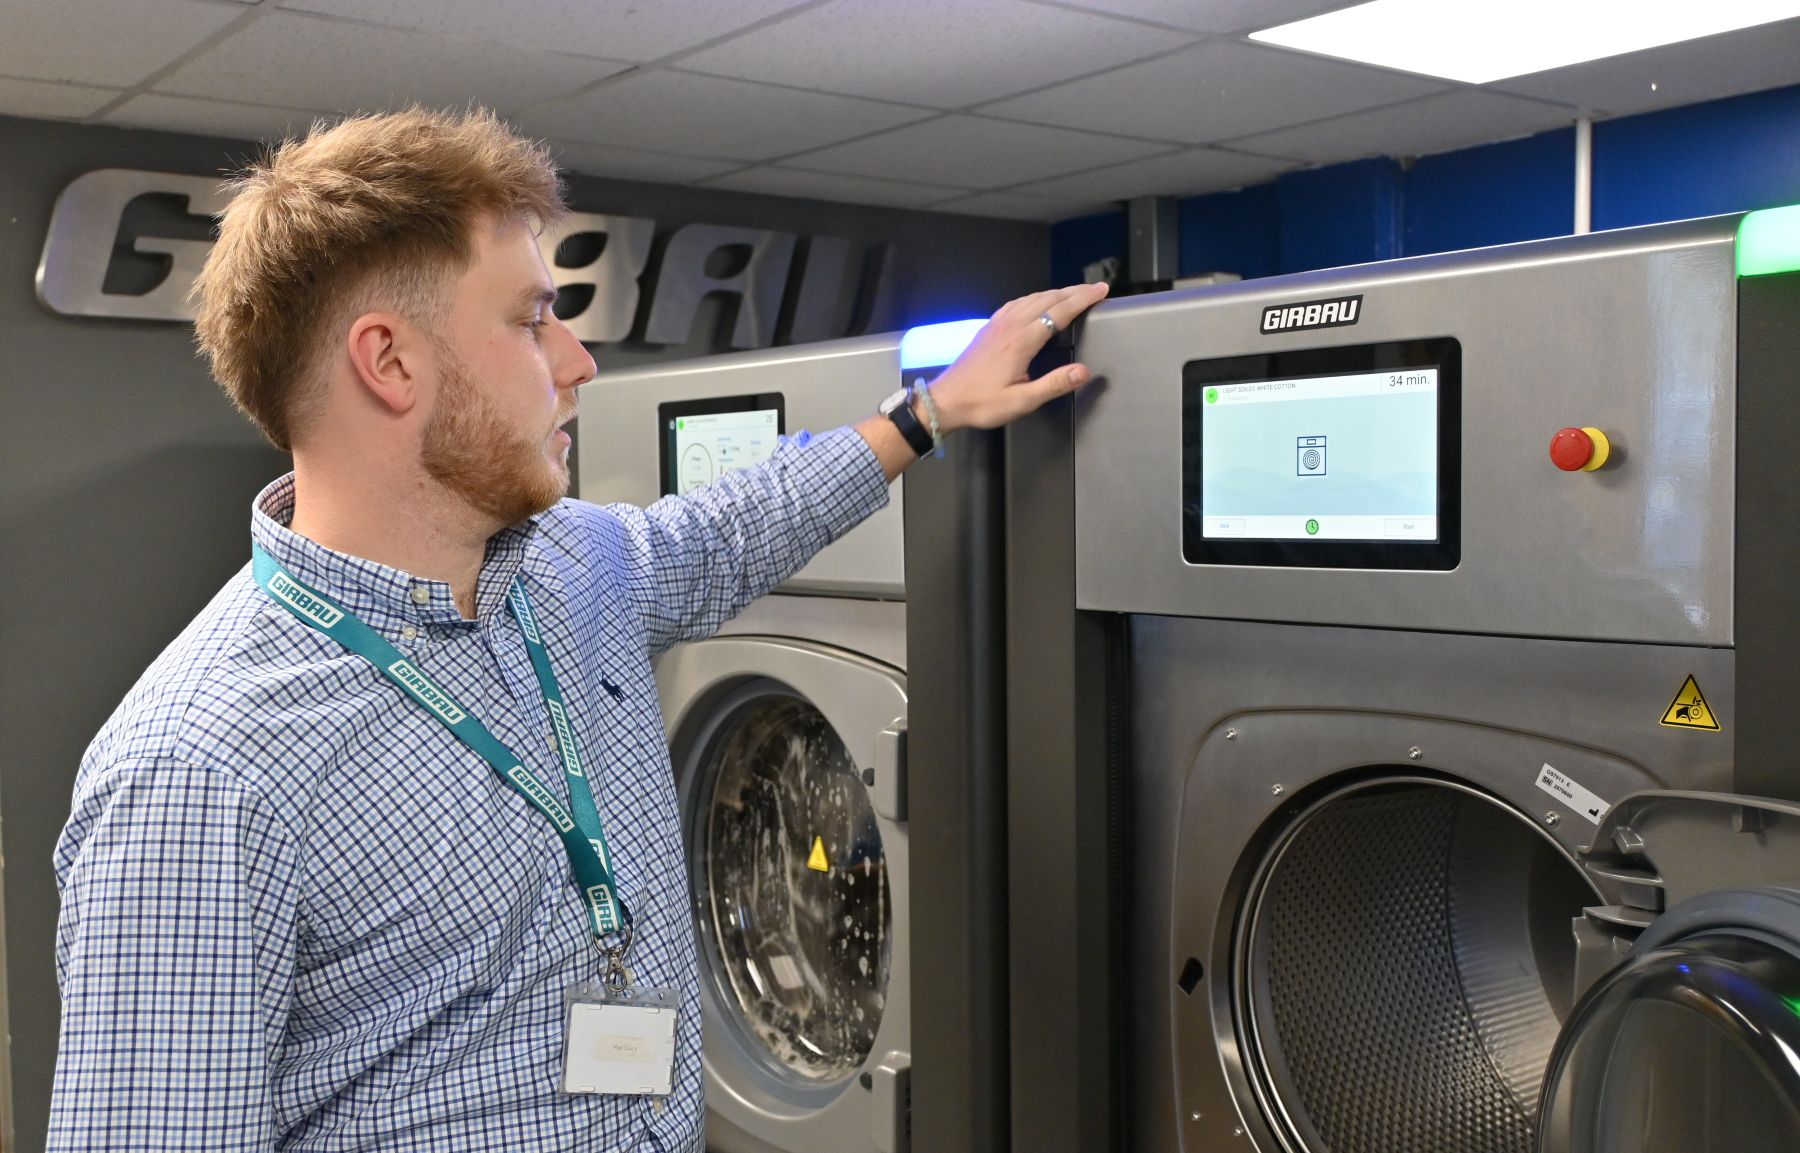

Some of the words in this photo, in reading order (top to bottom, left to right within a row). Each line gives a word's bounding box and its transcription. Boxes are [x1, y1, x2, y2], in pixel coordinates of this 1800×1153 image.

[34, 168, 897, 347] GBAU
[1263, 300, 1358, 330] GIRBAU
[1390, 375, 1403, 387] 34
[1406, 373, 1430, 386] min.
[271, 574, 339, 625] GIRBAU
[393, 663, 462, 722] GIRBAU
[552, 703, 579, 774] GIRBAU
[512, 769, 571, 829] GIRBAU
